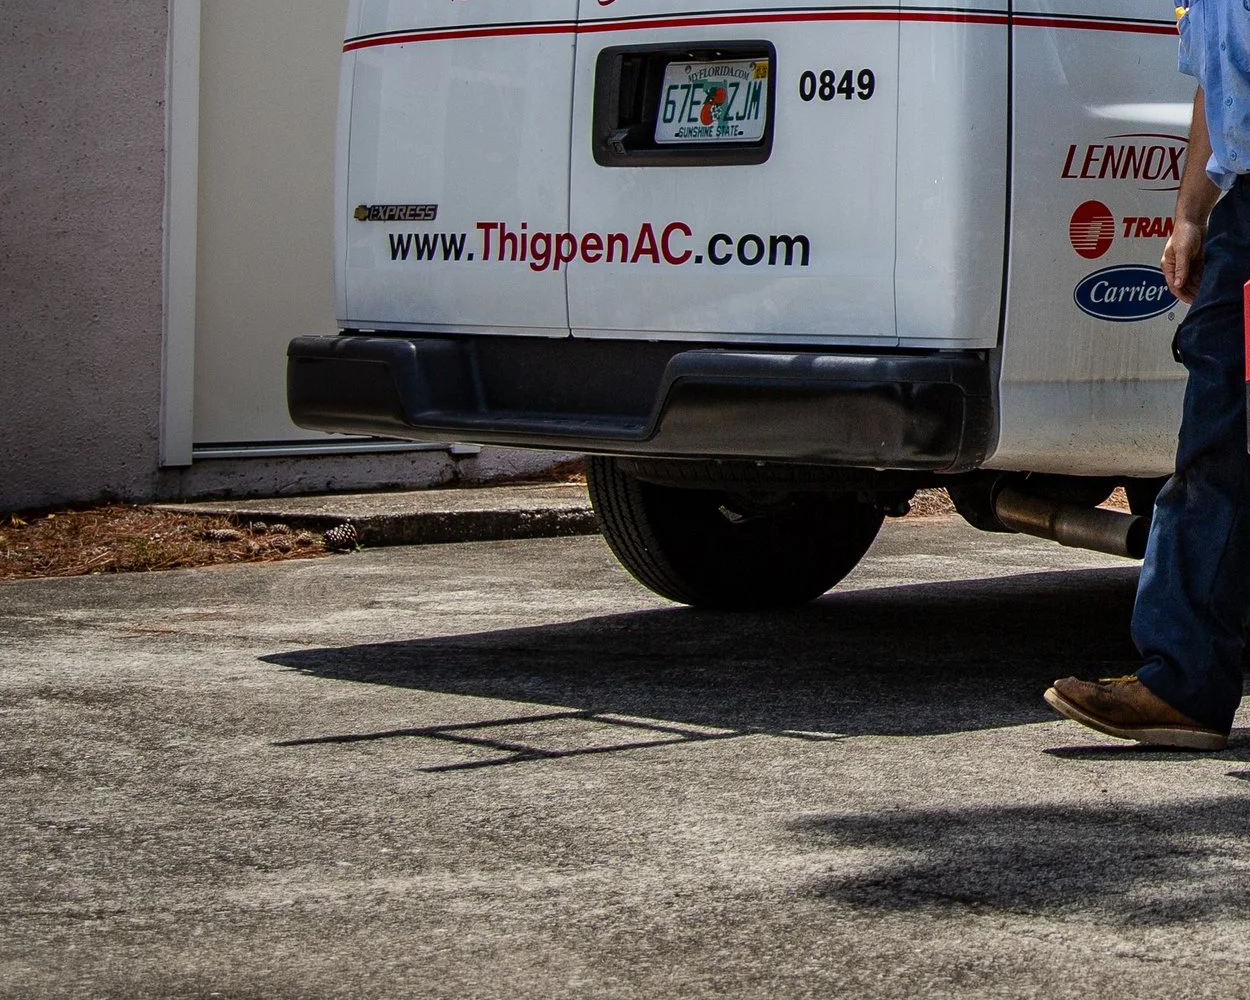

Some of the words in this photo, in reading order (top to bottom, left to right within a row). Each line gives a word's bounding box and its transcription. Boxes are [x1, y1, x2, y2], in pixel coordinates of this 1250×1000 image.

[798, 68, 875, 101] 0849
[663, 84, 705, 123] 67E
[723, 80, 762, 121] ZJM
[678, 127, 713, 138] SUNSHINE
[716, 125, 739, 137] STATE
[1061, 144, 1186, 181] LENNOX
[368, 205, 436, 220] EXPRESS
[388, 221, 811, 271] www.ThigpenAC.com
[1090, 279, 1168, 303] Carrier
